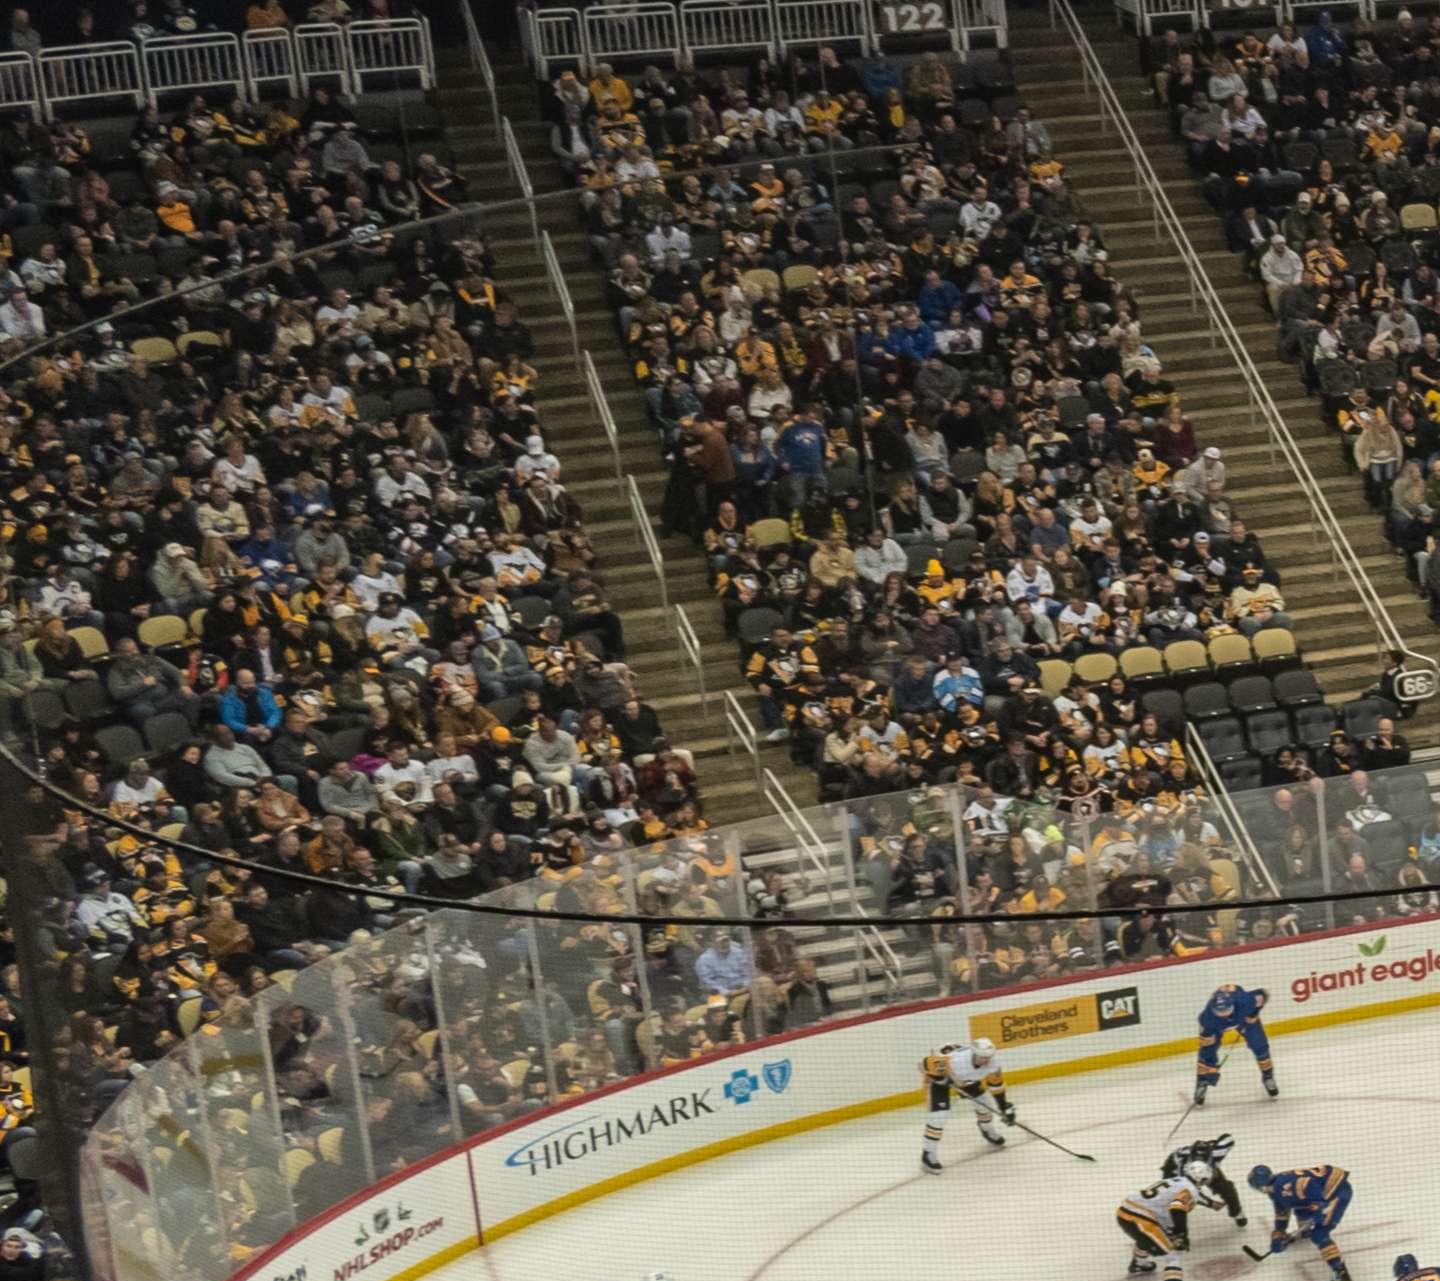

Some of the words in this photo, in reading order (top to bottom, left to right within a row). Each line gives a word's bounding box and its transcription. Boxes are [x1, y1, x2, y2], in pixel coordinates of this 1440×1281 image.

[883, 3, 946, 32] 122
[1291, 962, 1366, 1003] giant
[1000, 1003, 1078, 1030] Cleveland
[1101, 995, 1137, 1020] CAT
[1001, 1021, 1070, 1044] Brothers
[528, 1087, 715, 1177] HIGHMARK
